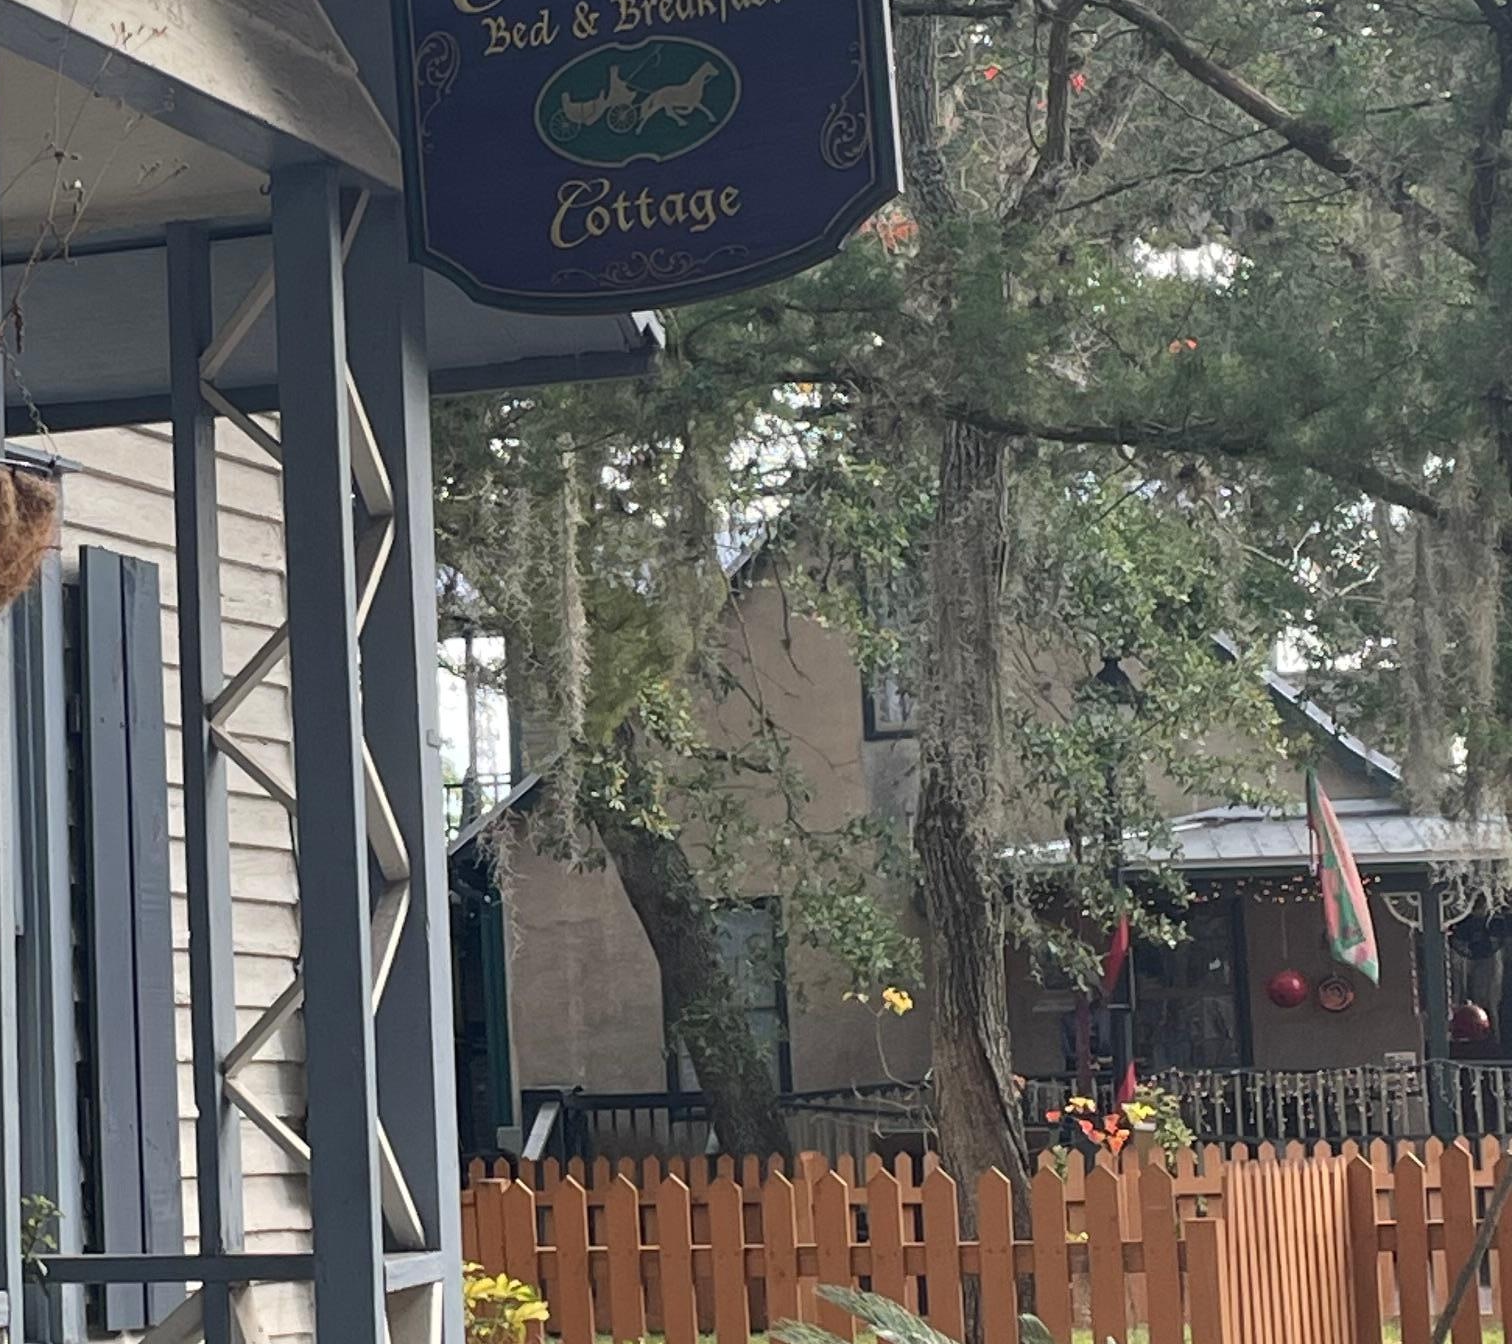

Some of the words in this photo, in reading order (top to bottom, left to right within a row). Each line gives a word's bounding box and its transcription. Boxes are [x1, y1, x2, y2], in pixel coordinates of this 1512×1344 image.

[481, 9, 560, 56] Bed
[572, 1, 599, 39] &
[550, 177, 742, 249] Cottage
